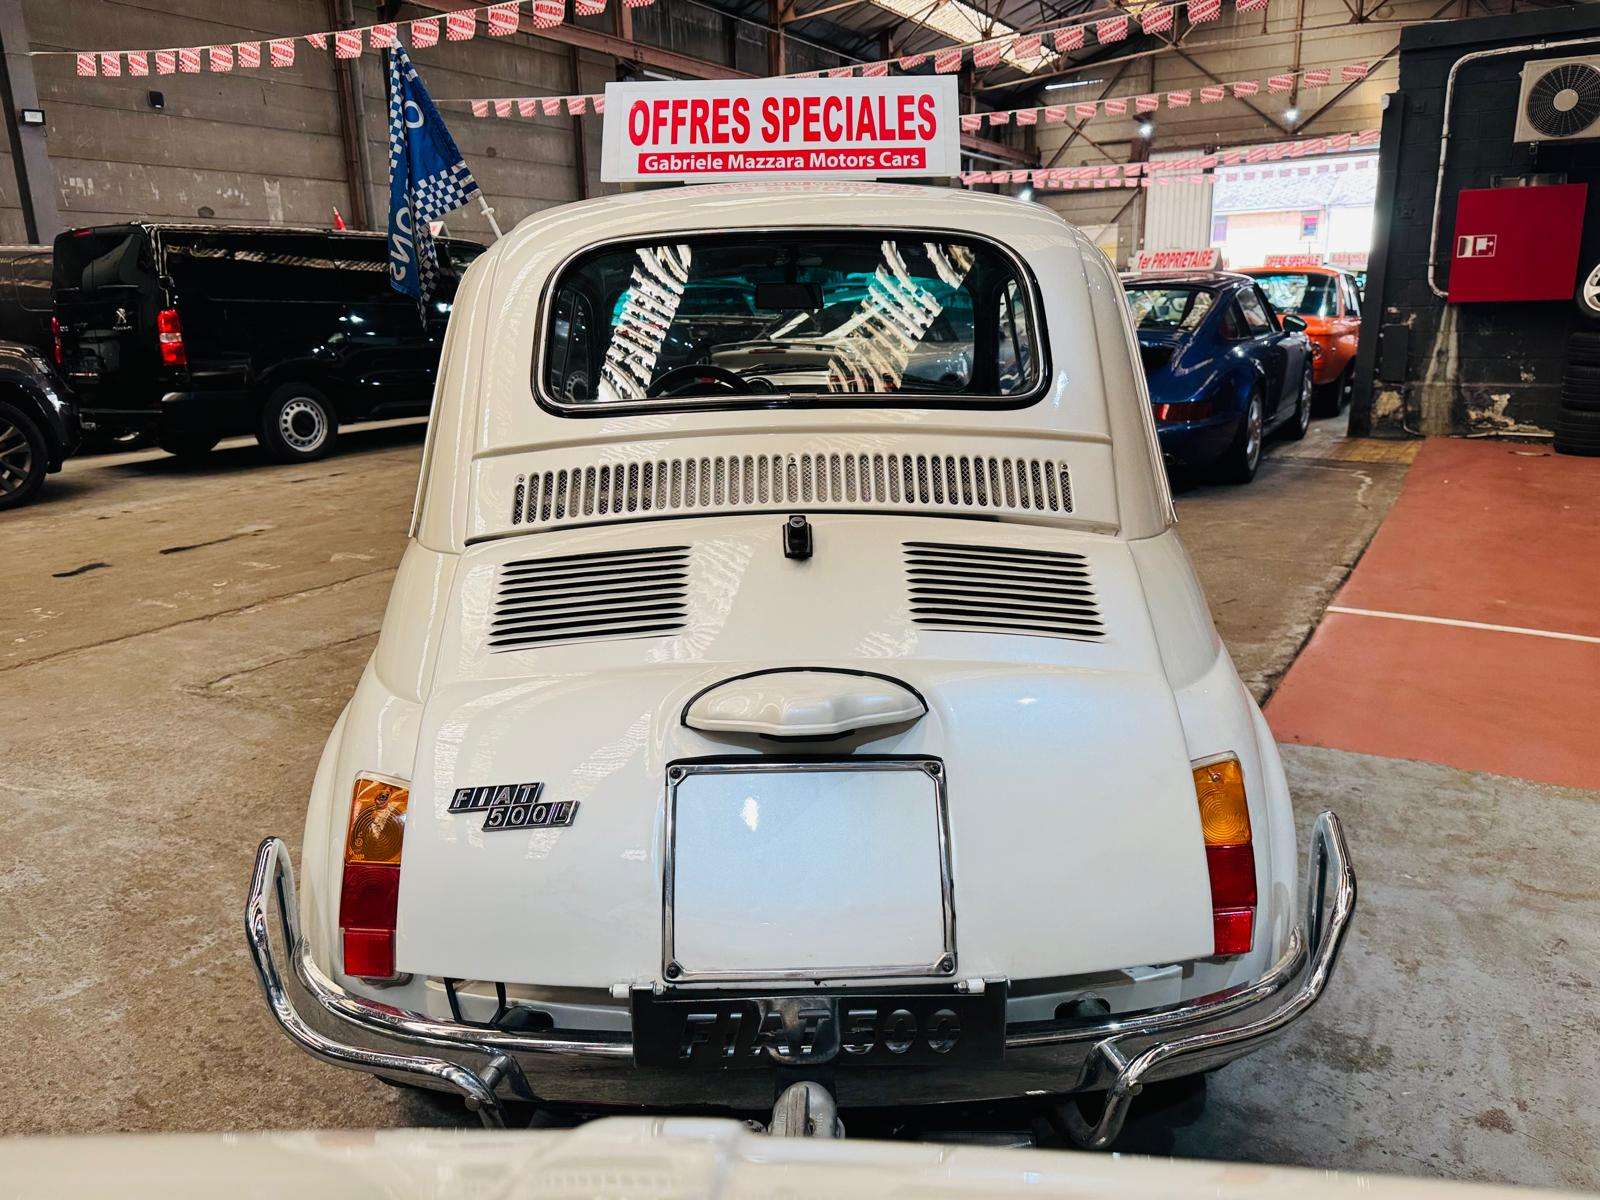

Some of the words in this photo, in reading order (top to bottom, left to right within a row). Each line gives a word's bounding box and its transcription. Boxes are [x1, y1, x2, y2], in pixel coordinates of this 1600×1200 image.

[1189, 0, 1220, 19] OCCASION
[628, 97, 750, 146] OFFRES
[761, 94, 937, 143] SPECIALES
[644, 154, 723, 172] Gabriele
[728, 154, 804, 169] Mazzara
[810, 152, 875, 168] Motors
[879, 151, 920, 167] Cars
[1137, 253, 1151, 269] 1er
[1152, 250, 1214, 269] PROPRIETAIRE
[453, 785, 536, 808] FIAT
[488, 801, 571, 827] 500L
[680, 1008, 831, 1058] FIAT
[842, 1008, 962, 1054] 500
